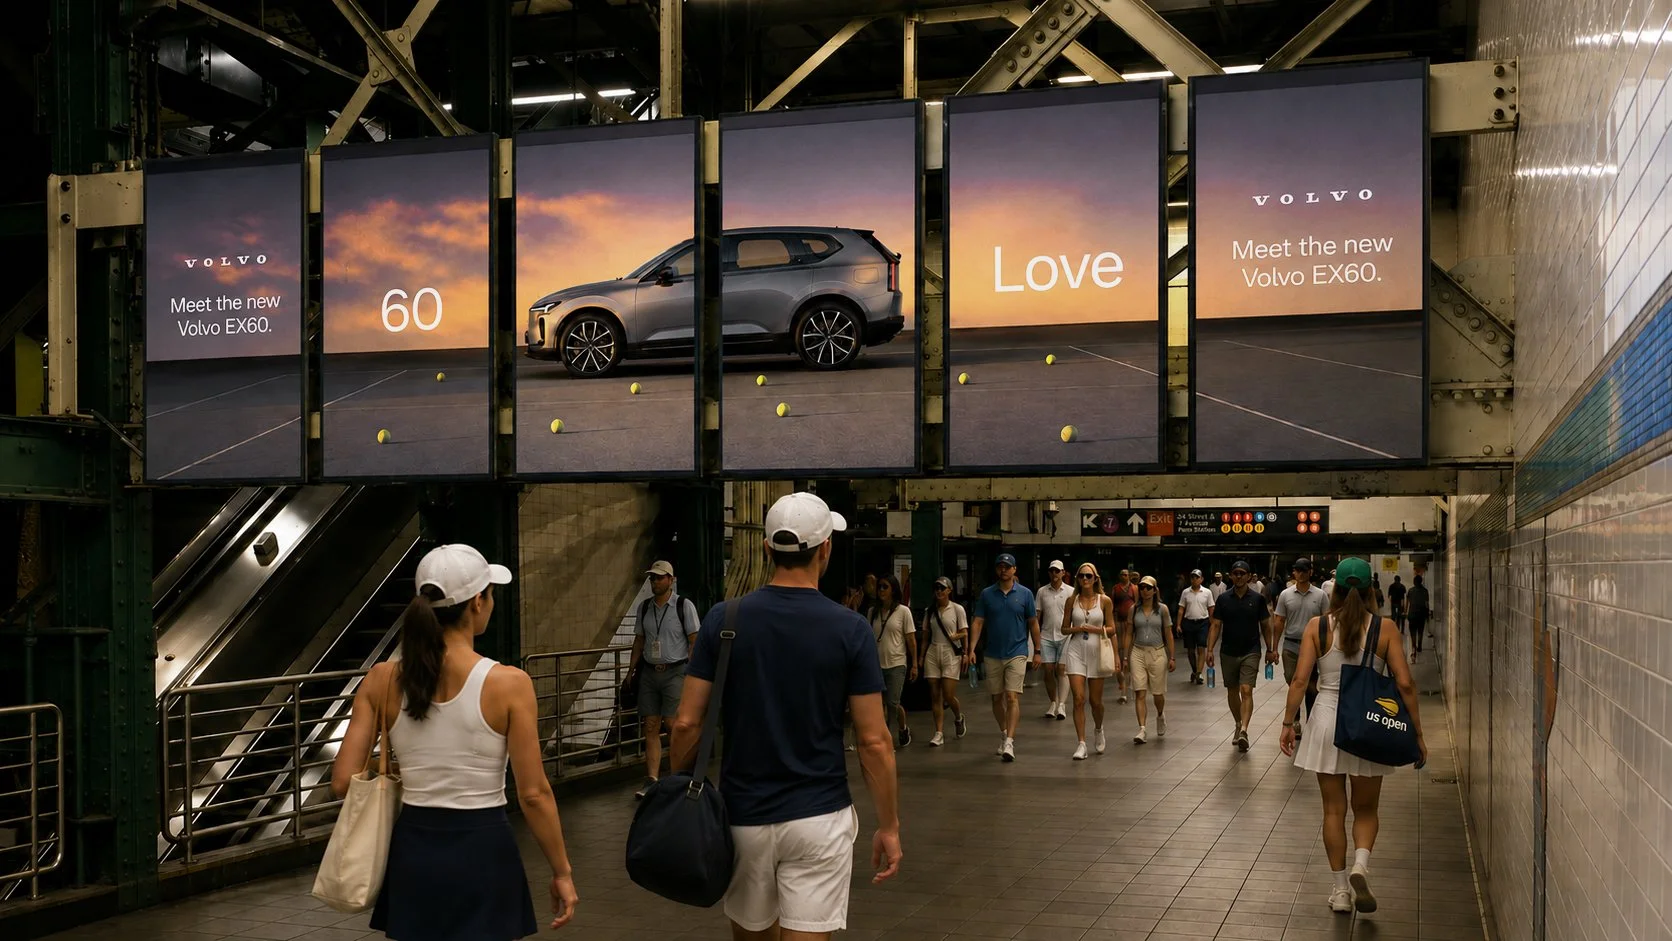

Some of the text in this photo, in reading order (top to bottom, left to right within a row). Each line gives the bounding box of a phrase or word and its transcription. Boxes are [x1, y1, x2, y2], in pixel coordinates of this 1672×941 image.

[1252, 189, 1373, 206] VOLVO
[1232, 236, 1394, 260] Meet the new
[184, 254, 267, 268] VOLVO
[994, 246, 1124, 293] Love
[1242, 262, 1382, 288] Volvo EX60.
[170, 295, 281, 314] Meet the new
[381, 288, 443, 333] 60
[177, 317, 272, 336] Volvo EX60.
[1150, 513, 1172, 524] Exit
[1366, 711, 1407, 732] us open
